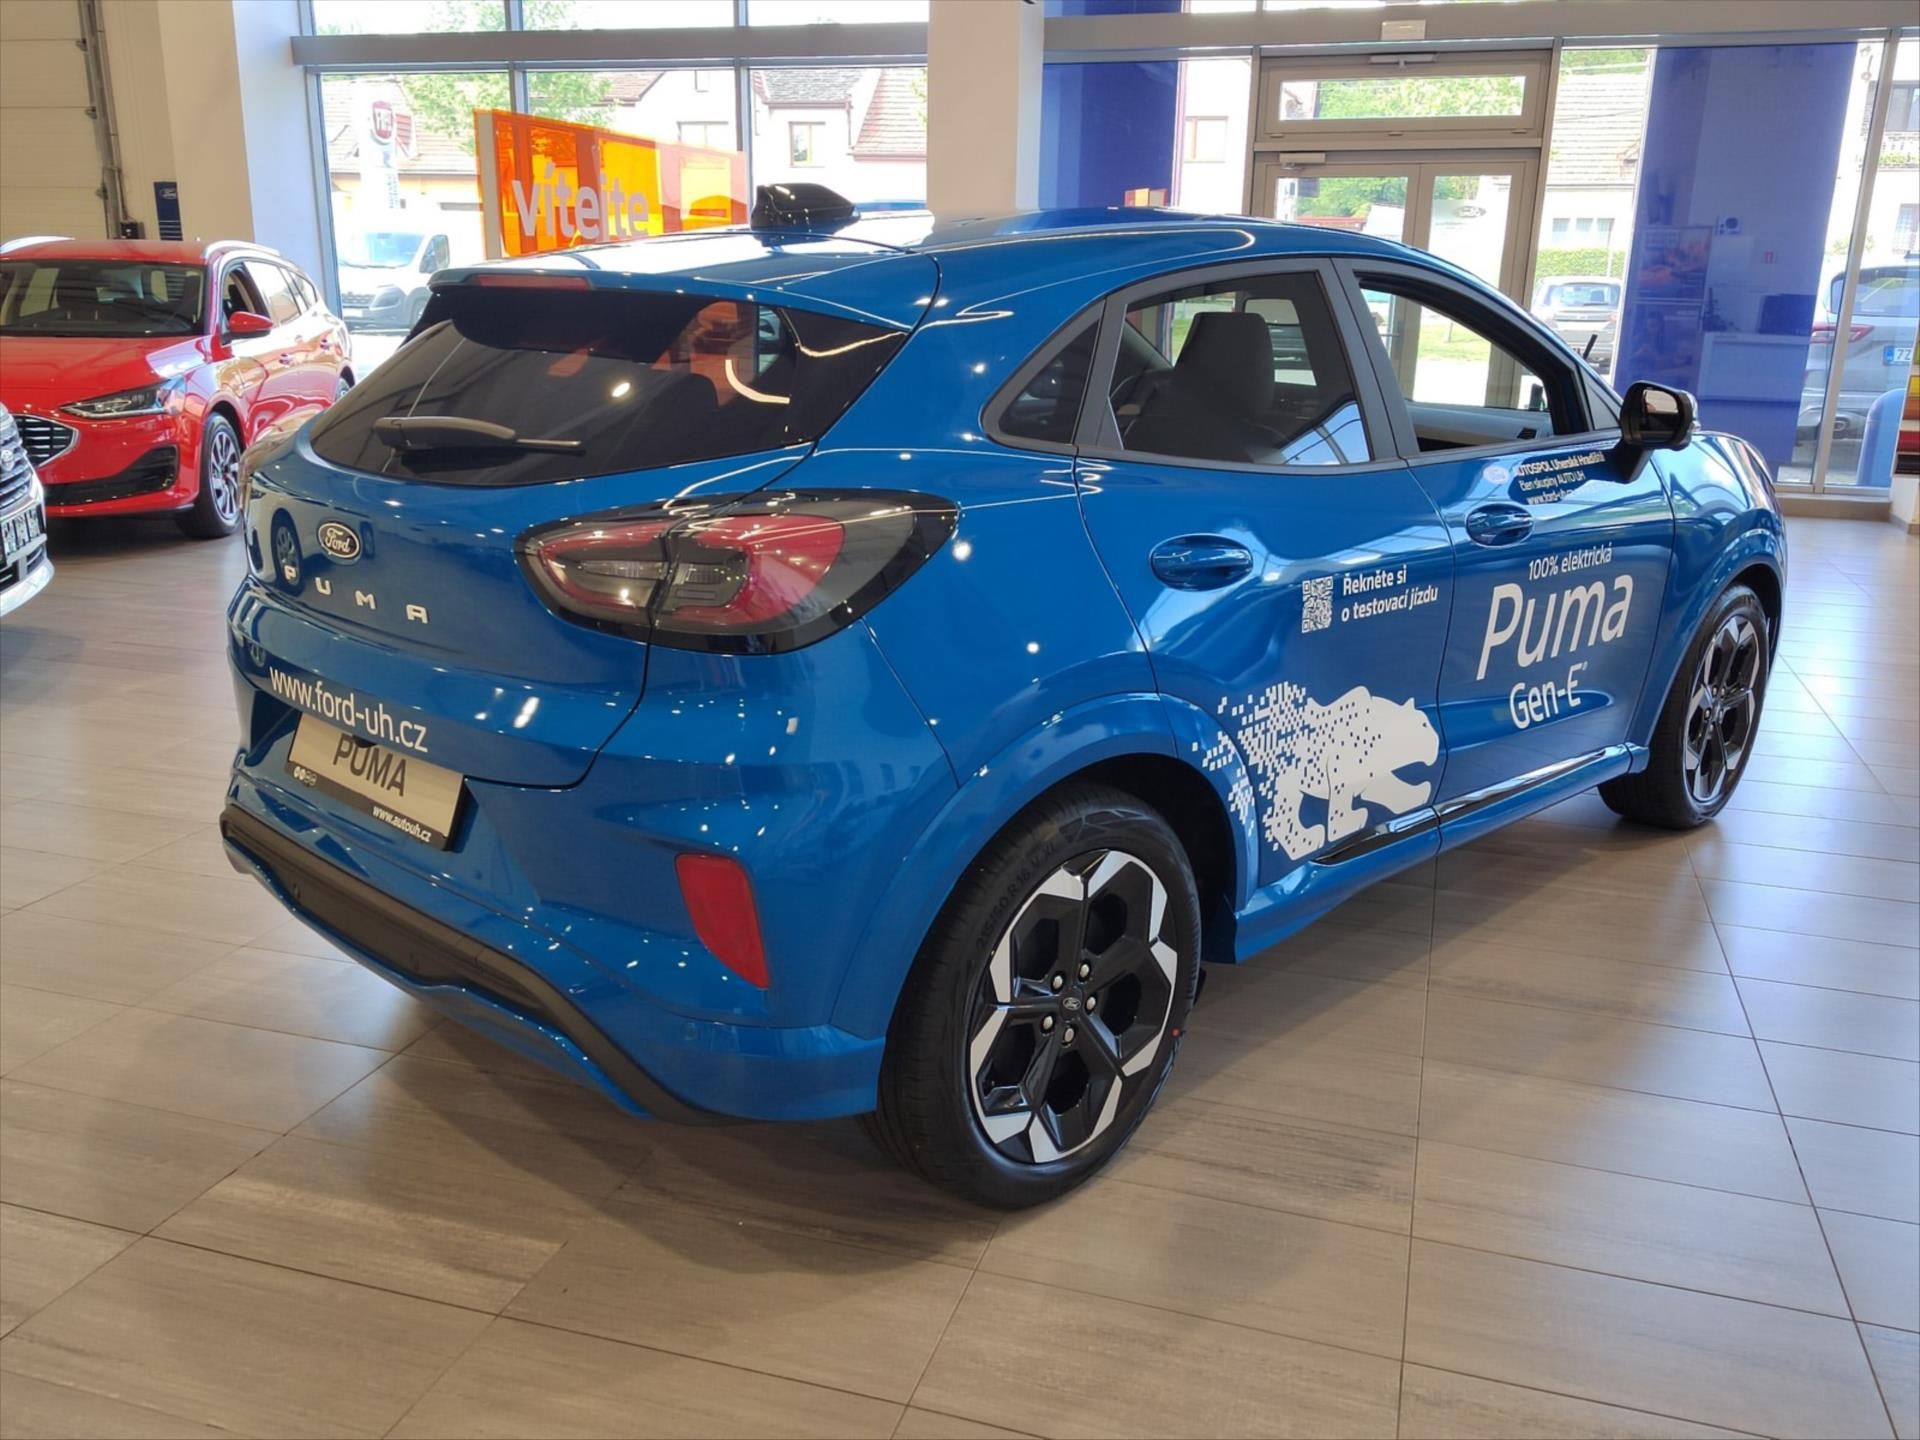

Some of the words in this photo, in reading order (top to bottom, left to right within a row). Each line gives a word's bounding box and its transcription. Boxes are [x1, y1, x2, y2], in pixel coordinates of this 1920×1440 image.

[1514, 461, 1554, 478] UTOSPOL
[324, 527, 351, 553] Ford
[1343, 569, 1394, 596] Řekněte
[1397, 564, 1407, 585] si
[1528, 555, 1559, 581] 100%
[1561, 541, 1613, 573] elektrická
[284, 565, 428, 624] PUMA
[1341, 607, 1350, 622] o
[1353, 588, 1409, 619] testovací
[1408, 585, 1439, 611] jízdu
[1476, 574, 1634, 681] Puma
[269, 666, 429, 753] www.ford-uh.cz
[332, 733, 407, 797] PUMA
[372, 805, 432, 842] www.autouh.cz
